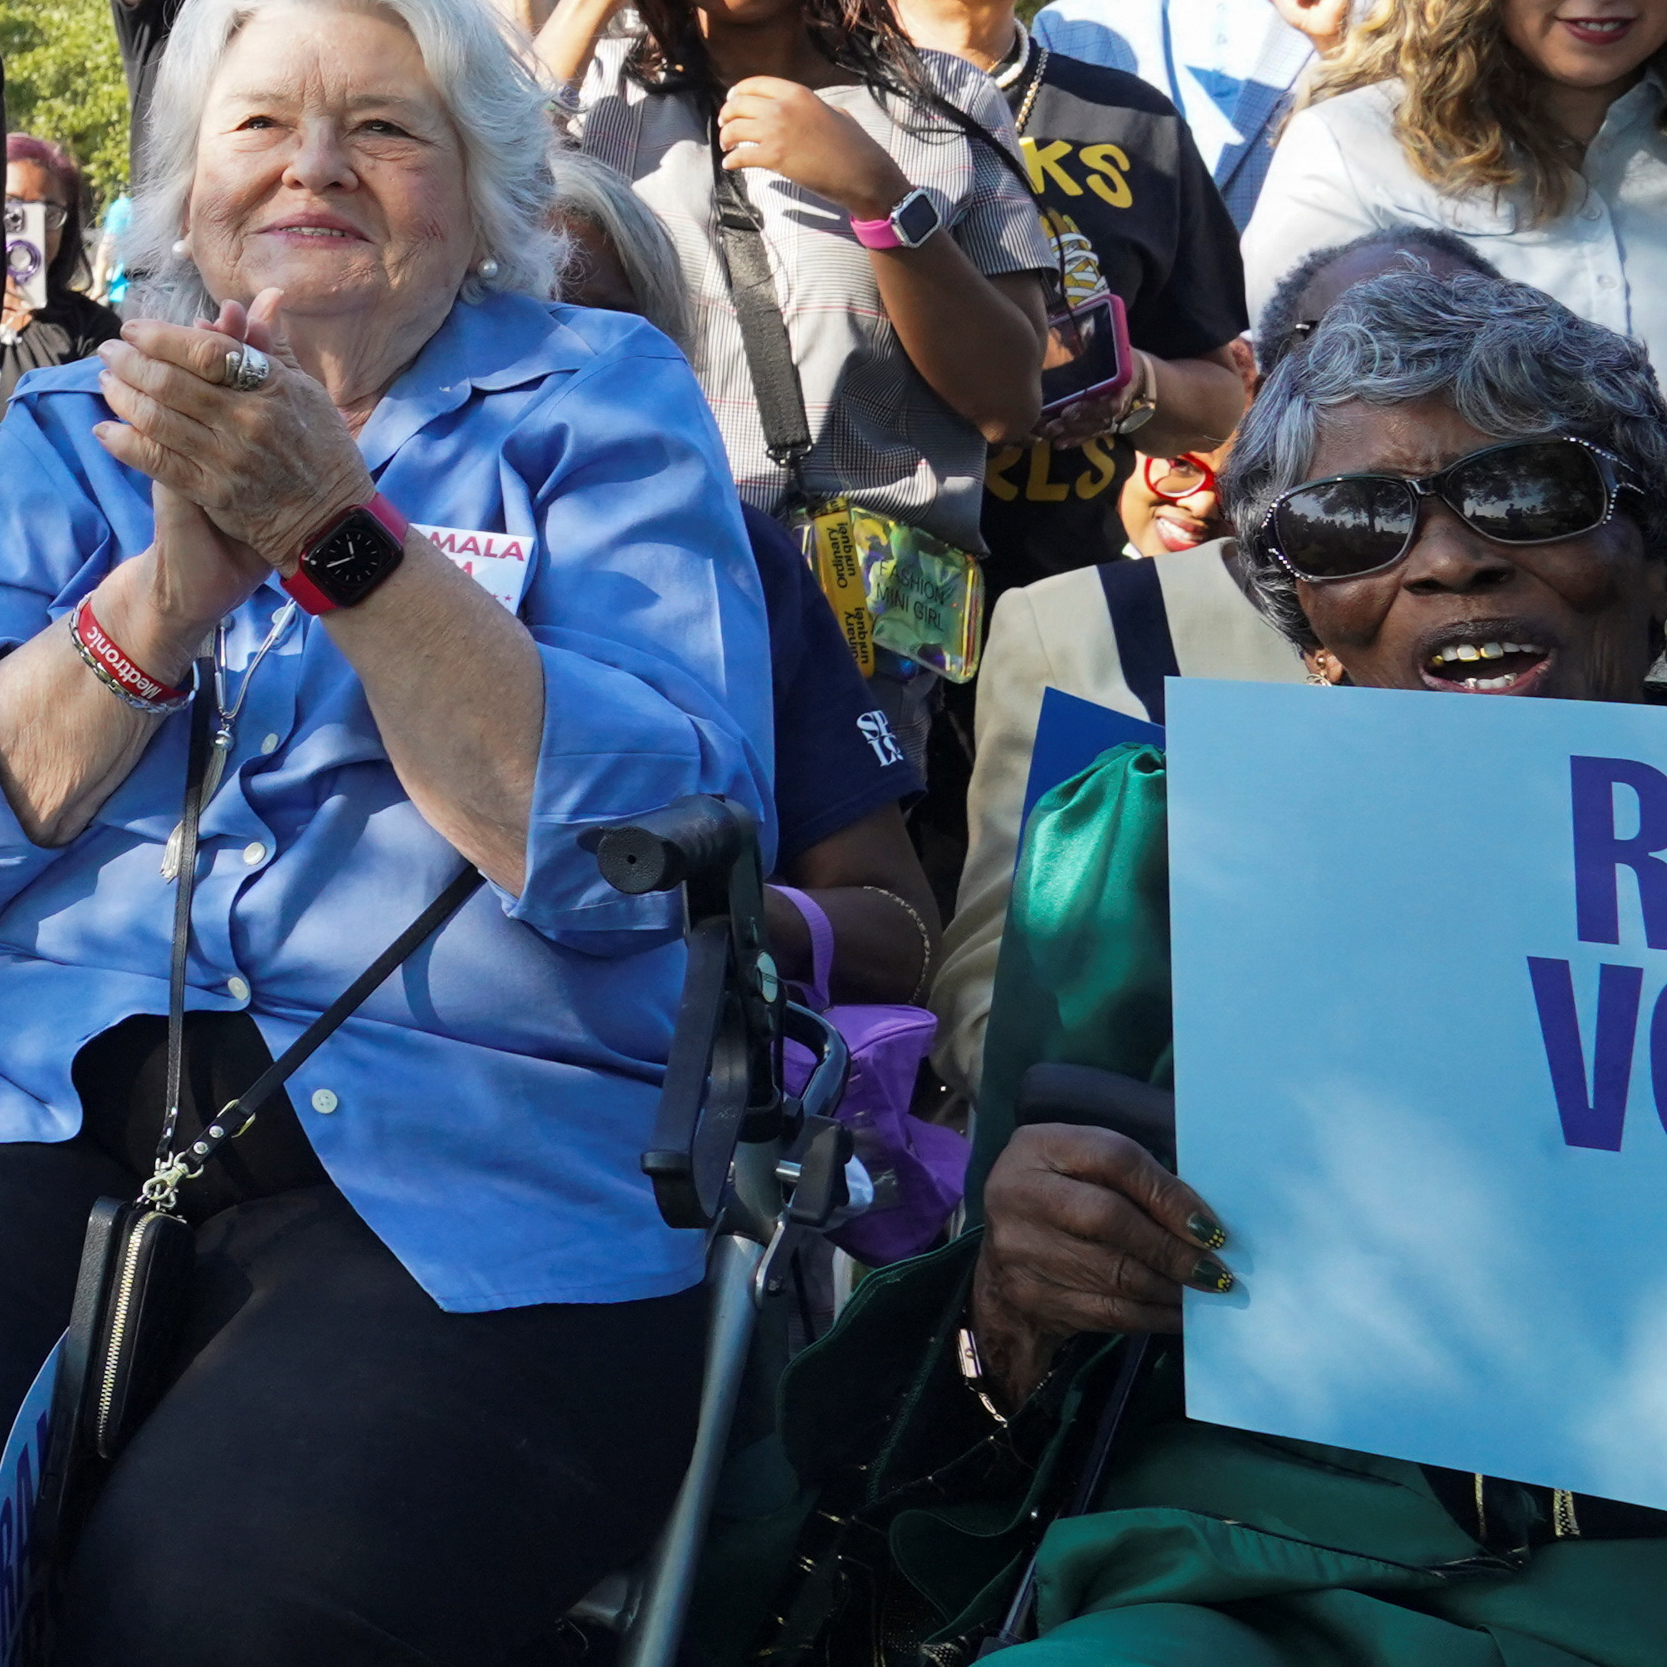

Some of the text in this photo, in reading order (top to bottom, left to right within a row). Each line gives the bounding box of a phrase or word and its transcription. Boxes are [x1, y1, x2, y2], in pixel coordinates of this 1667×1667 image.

[1019, 136, 1134, 210] KS
[428, 531, 525, 562] MALA
[876, 582, 944, 632] MINI GIRL
[879, 559, 946, 606] FASHION
[86, 625, 163, 700] Medtronic
